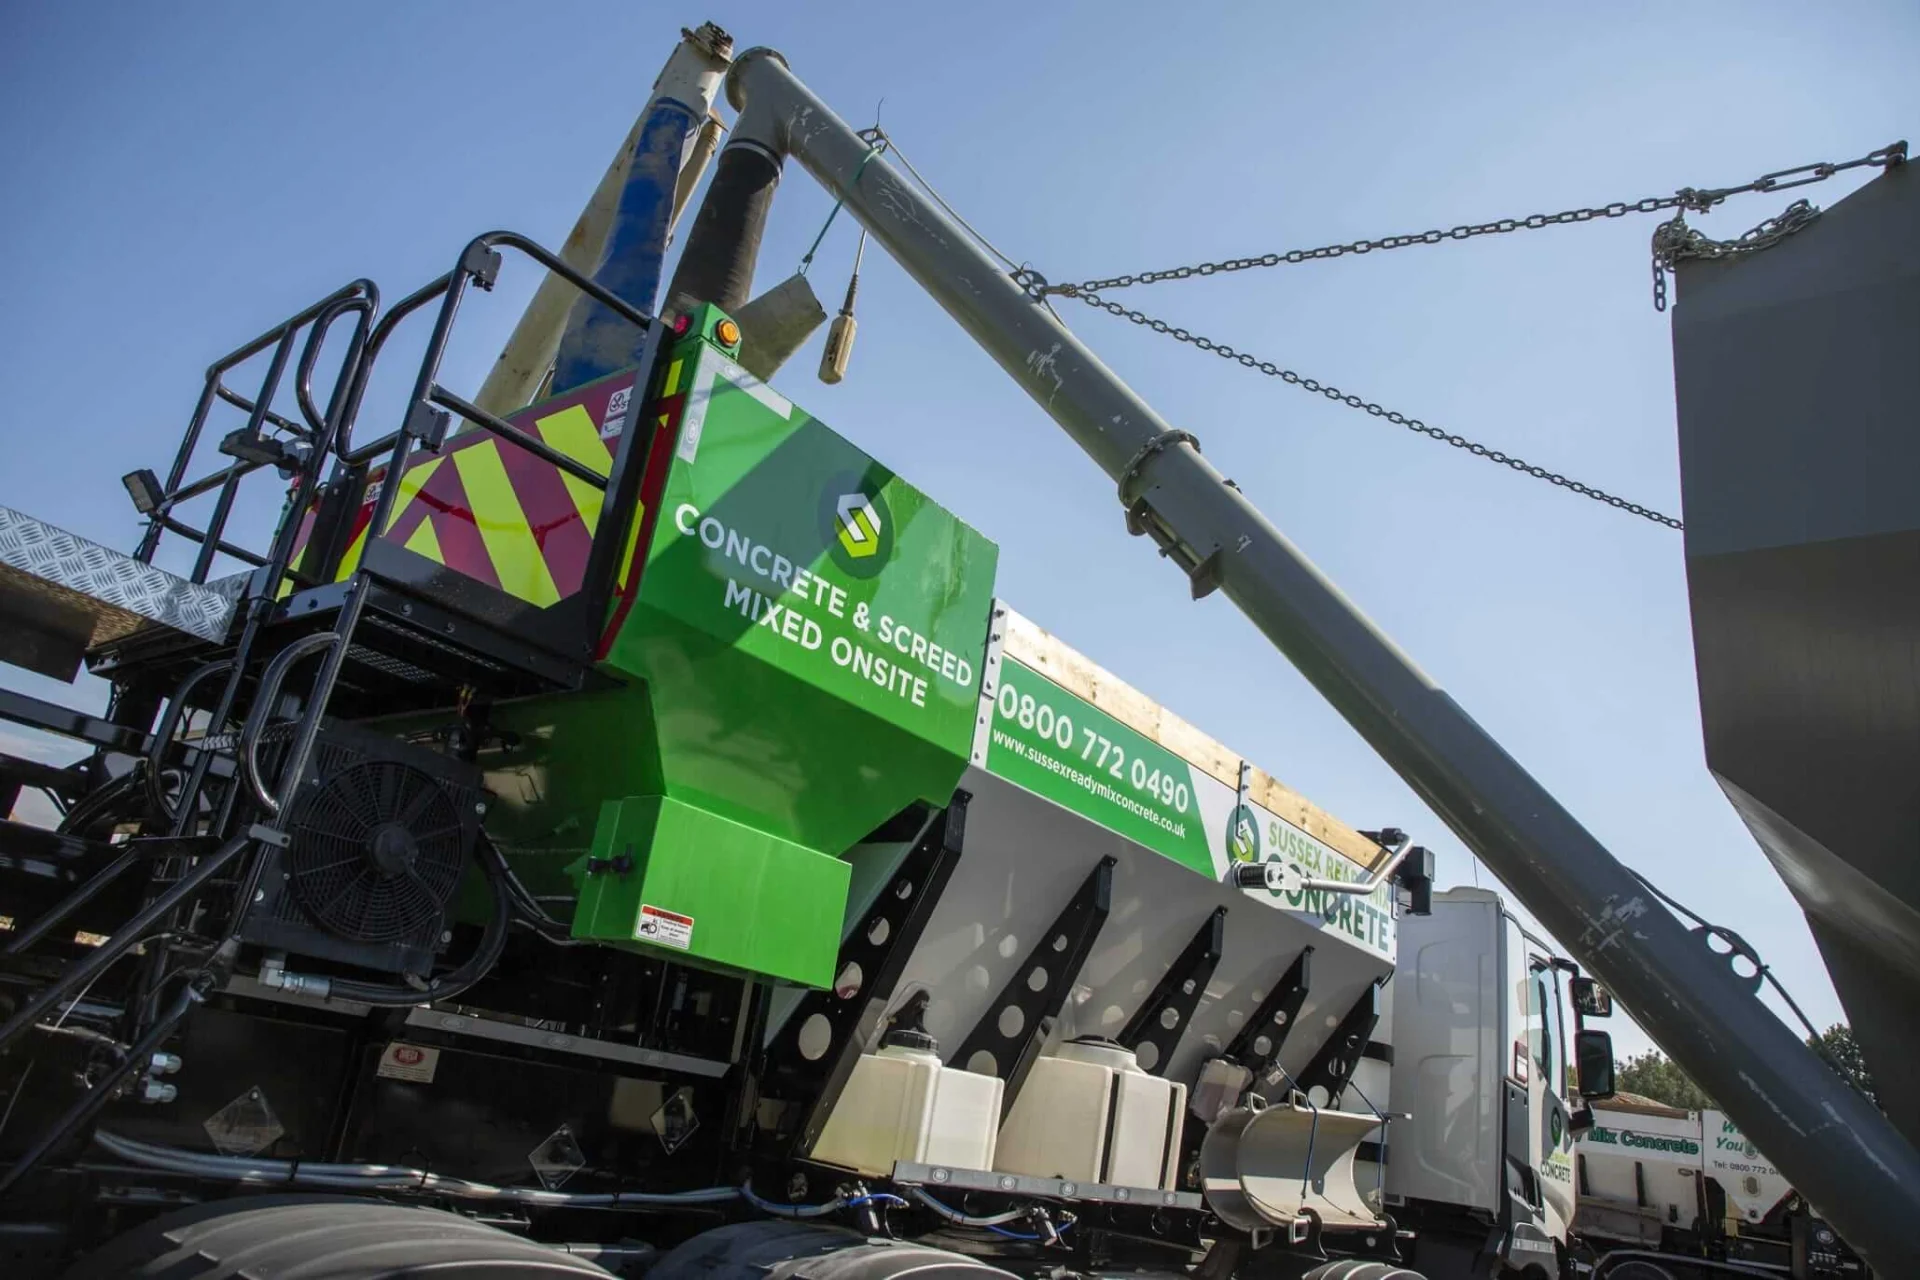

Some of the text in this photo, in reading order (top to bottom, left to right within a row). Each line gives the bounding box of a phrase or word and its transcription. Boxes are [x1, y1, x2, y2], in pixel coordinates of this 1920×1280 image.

[675, 503, 972, 688] CONCRETE & SCREED
[723, 578, 928, 708] MIXED ONSITE
[992, 728, 1186, 839] www.sussexreadymixconcrete.co.uk
[998, 683, 1189, 814] 0800 772 0490
[1268, 821, 1322, 873] SUSSEX
[1541, 1160, 1571, 1184] CONCRETE
[1620, 1130, 1699, 1155] Concrete
